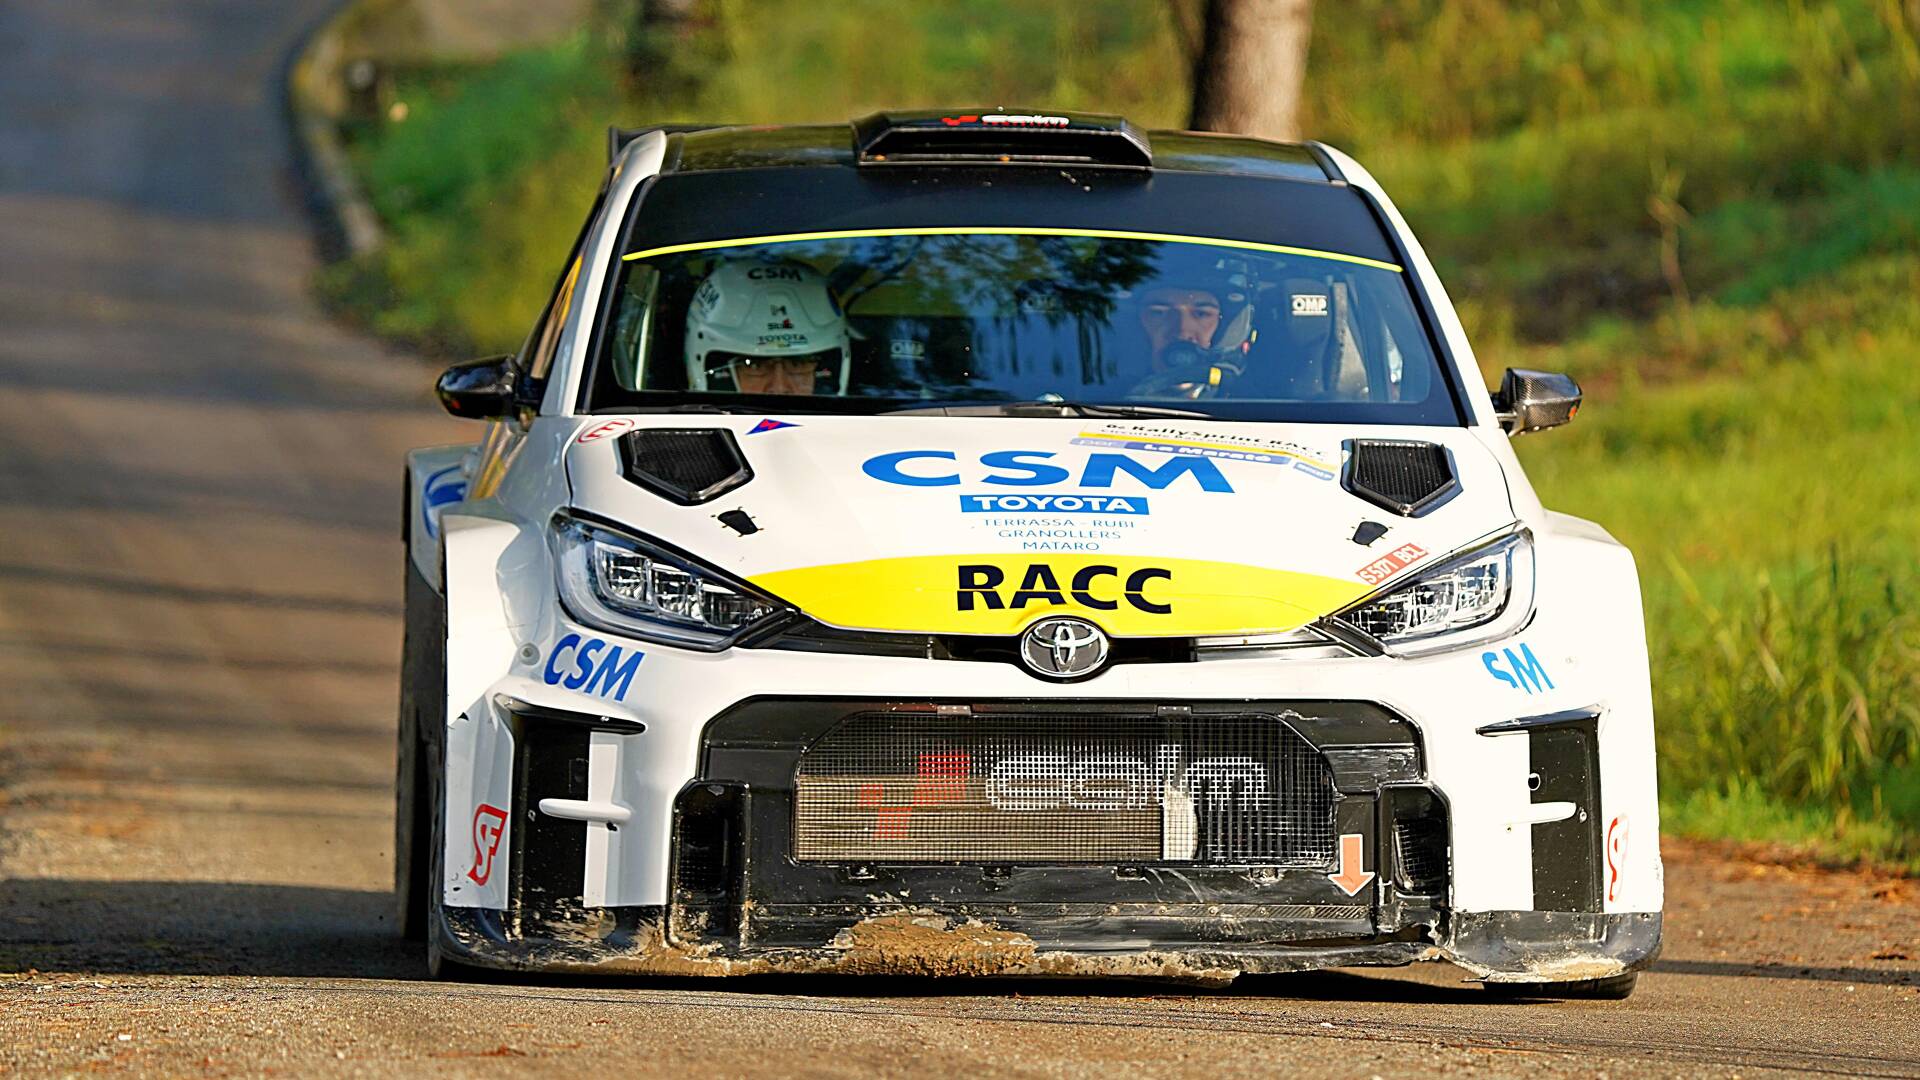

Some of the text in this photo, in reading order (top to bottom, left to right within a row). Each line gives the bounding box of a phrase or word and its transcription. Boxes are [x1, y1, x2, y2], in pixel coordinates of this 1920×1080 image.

[747, 267, 803, 281] CSM
[1292, 295, 1328, 313] OMP
[758, 333, 808, 343] TOYOTA
[1144, 443, 1174, 453] La
[862, 451, 1235, 493] CSM
[972, 496, 1136, 513] TOYOTA
[985, 518, 1075, 527] TERRASSA
[1093, 519, 1135, 529] RUBI
[998, 529, 1121, 539] GRANOLLERS
[1022, 541, 1100, 551] MATARO
[957, 564, 1172, 615] RACC
[543, 633, 645, 702] CSM
